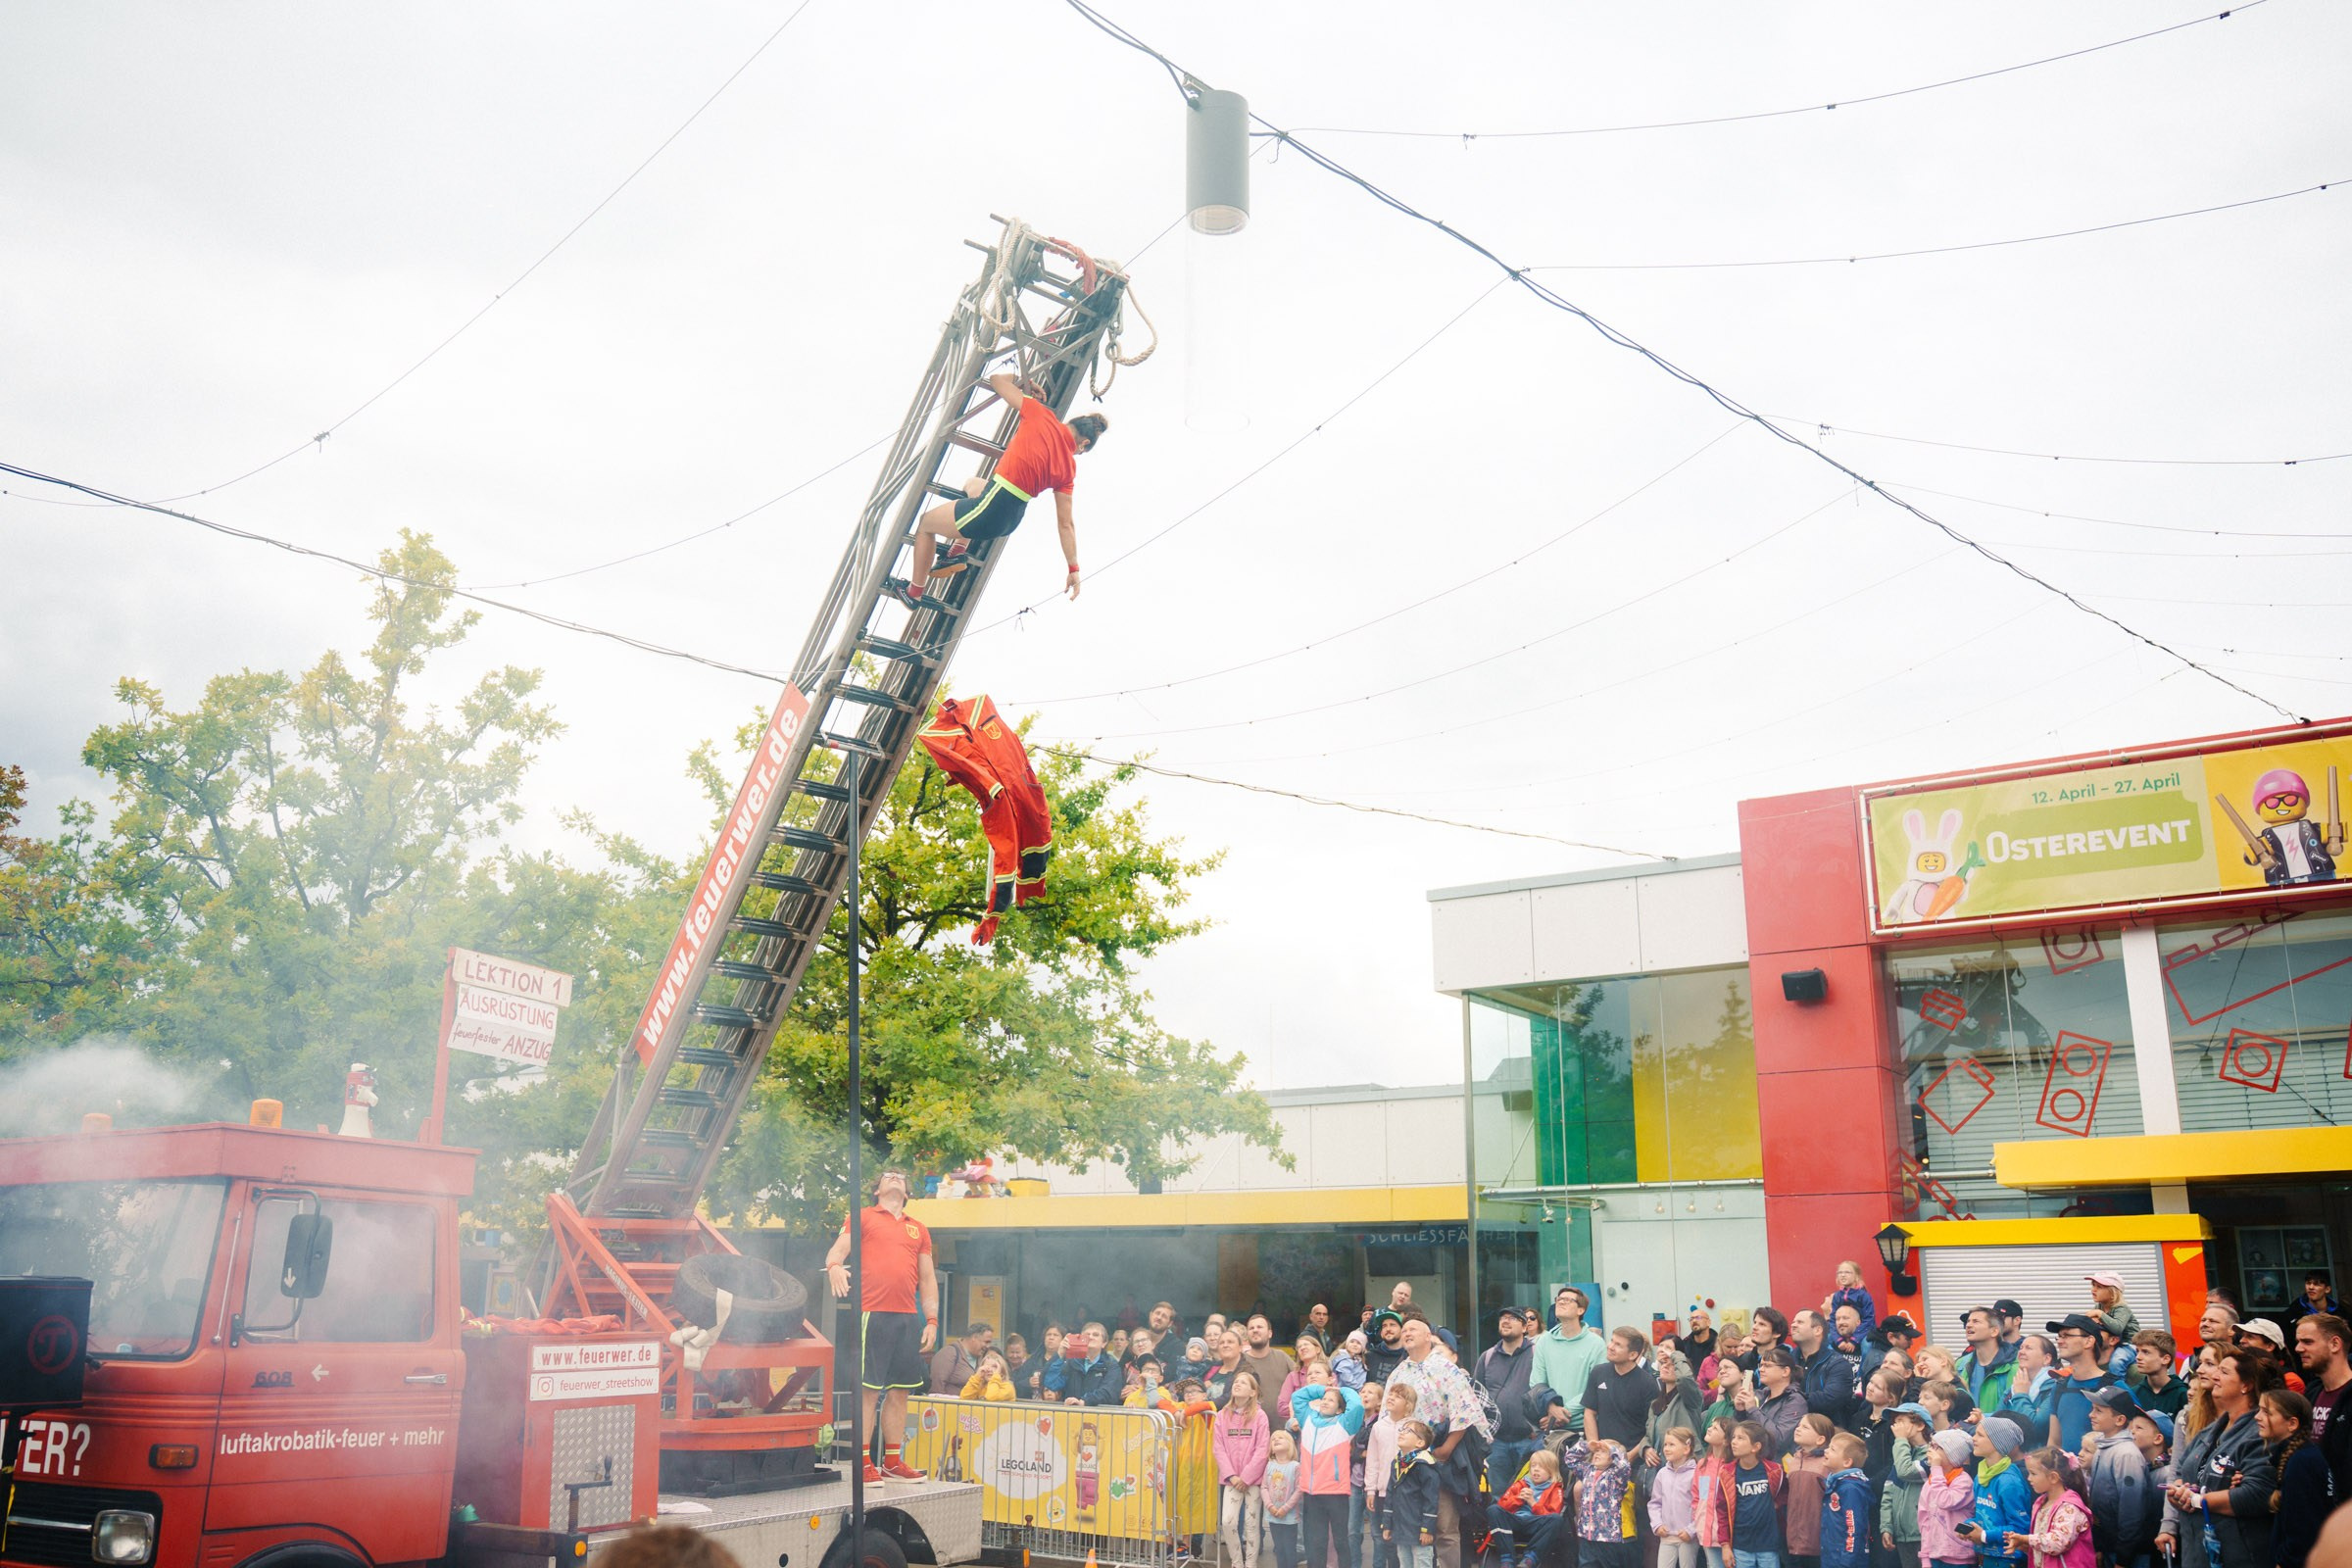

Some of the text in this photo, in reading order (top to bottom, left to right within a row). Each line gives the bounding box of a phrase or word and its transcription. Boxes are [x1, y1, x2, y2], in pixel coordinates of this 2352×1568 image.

[2032, 791, 2054, 805] 12.
[2059, 783, 2096, 803] April
[2114, 780, 2136, 794] 27.
[2142, 772, 2180, 791] April
[642, 707, 799, 1048] www.feuerwer.de
[465, 959, 562, 1001] LEKTION 1
[459, 991, 555, 1030] AUSRÜSTUNG
[452, 1023, 552, 1060] feuerfester ANZUG
[1369, 1226, 1516, 1245] SCHLIESSFÄHER
[541, 1346, 652, 1366] www.feuerwer.de
[255, 1371, 292, 1385] 608
[560, 1376, 654, 1392] feuerwer_streetshow
[220, 1427, 445, 1454] luftakrobatik-feuer + mehr
[1001, 1453, 1052, 1473] LEGOLAND
[1736, 1479, 1769, 1496] VANS
